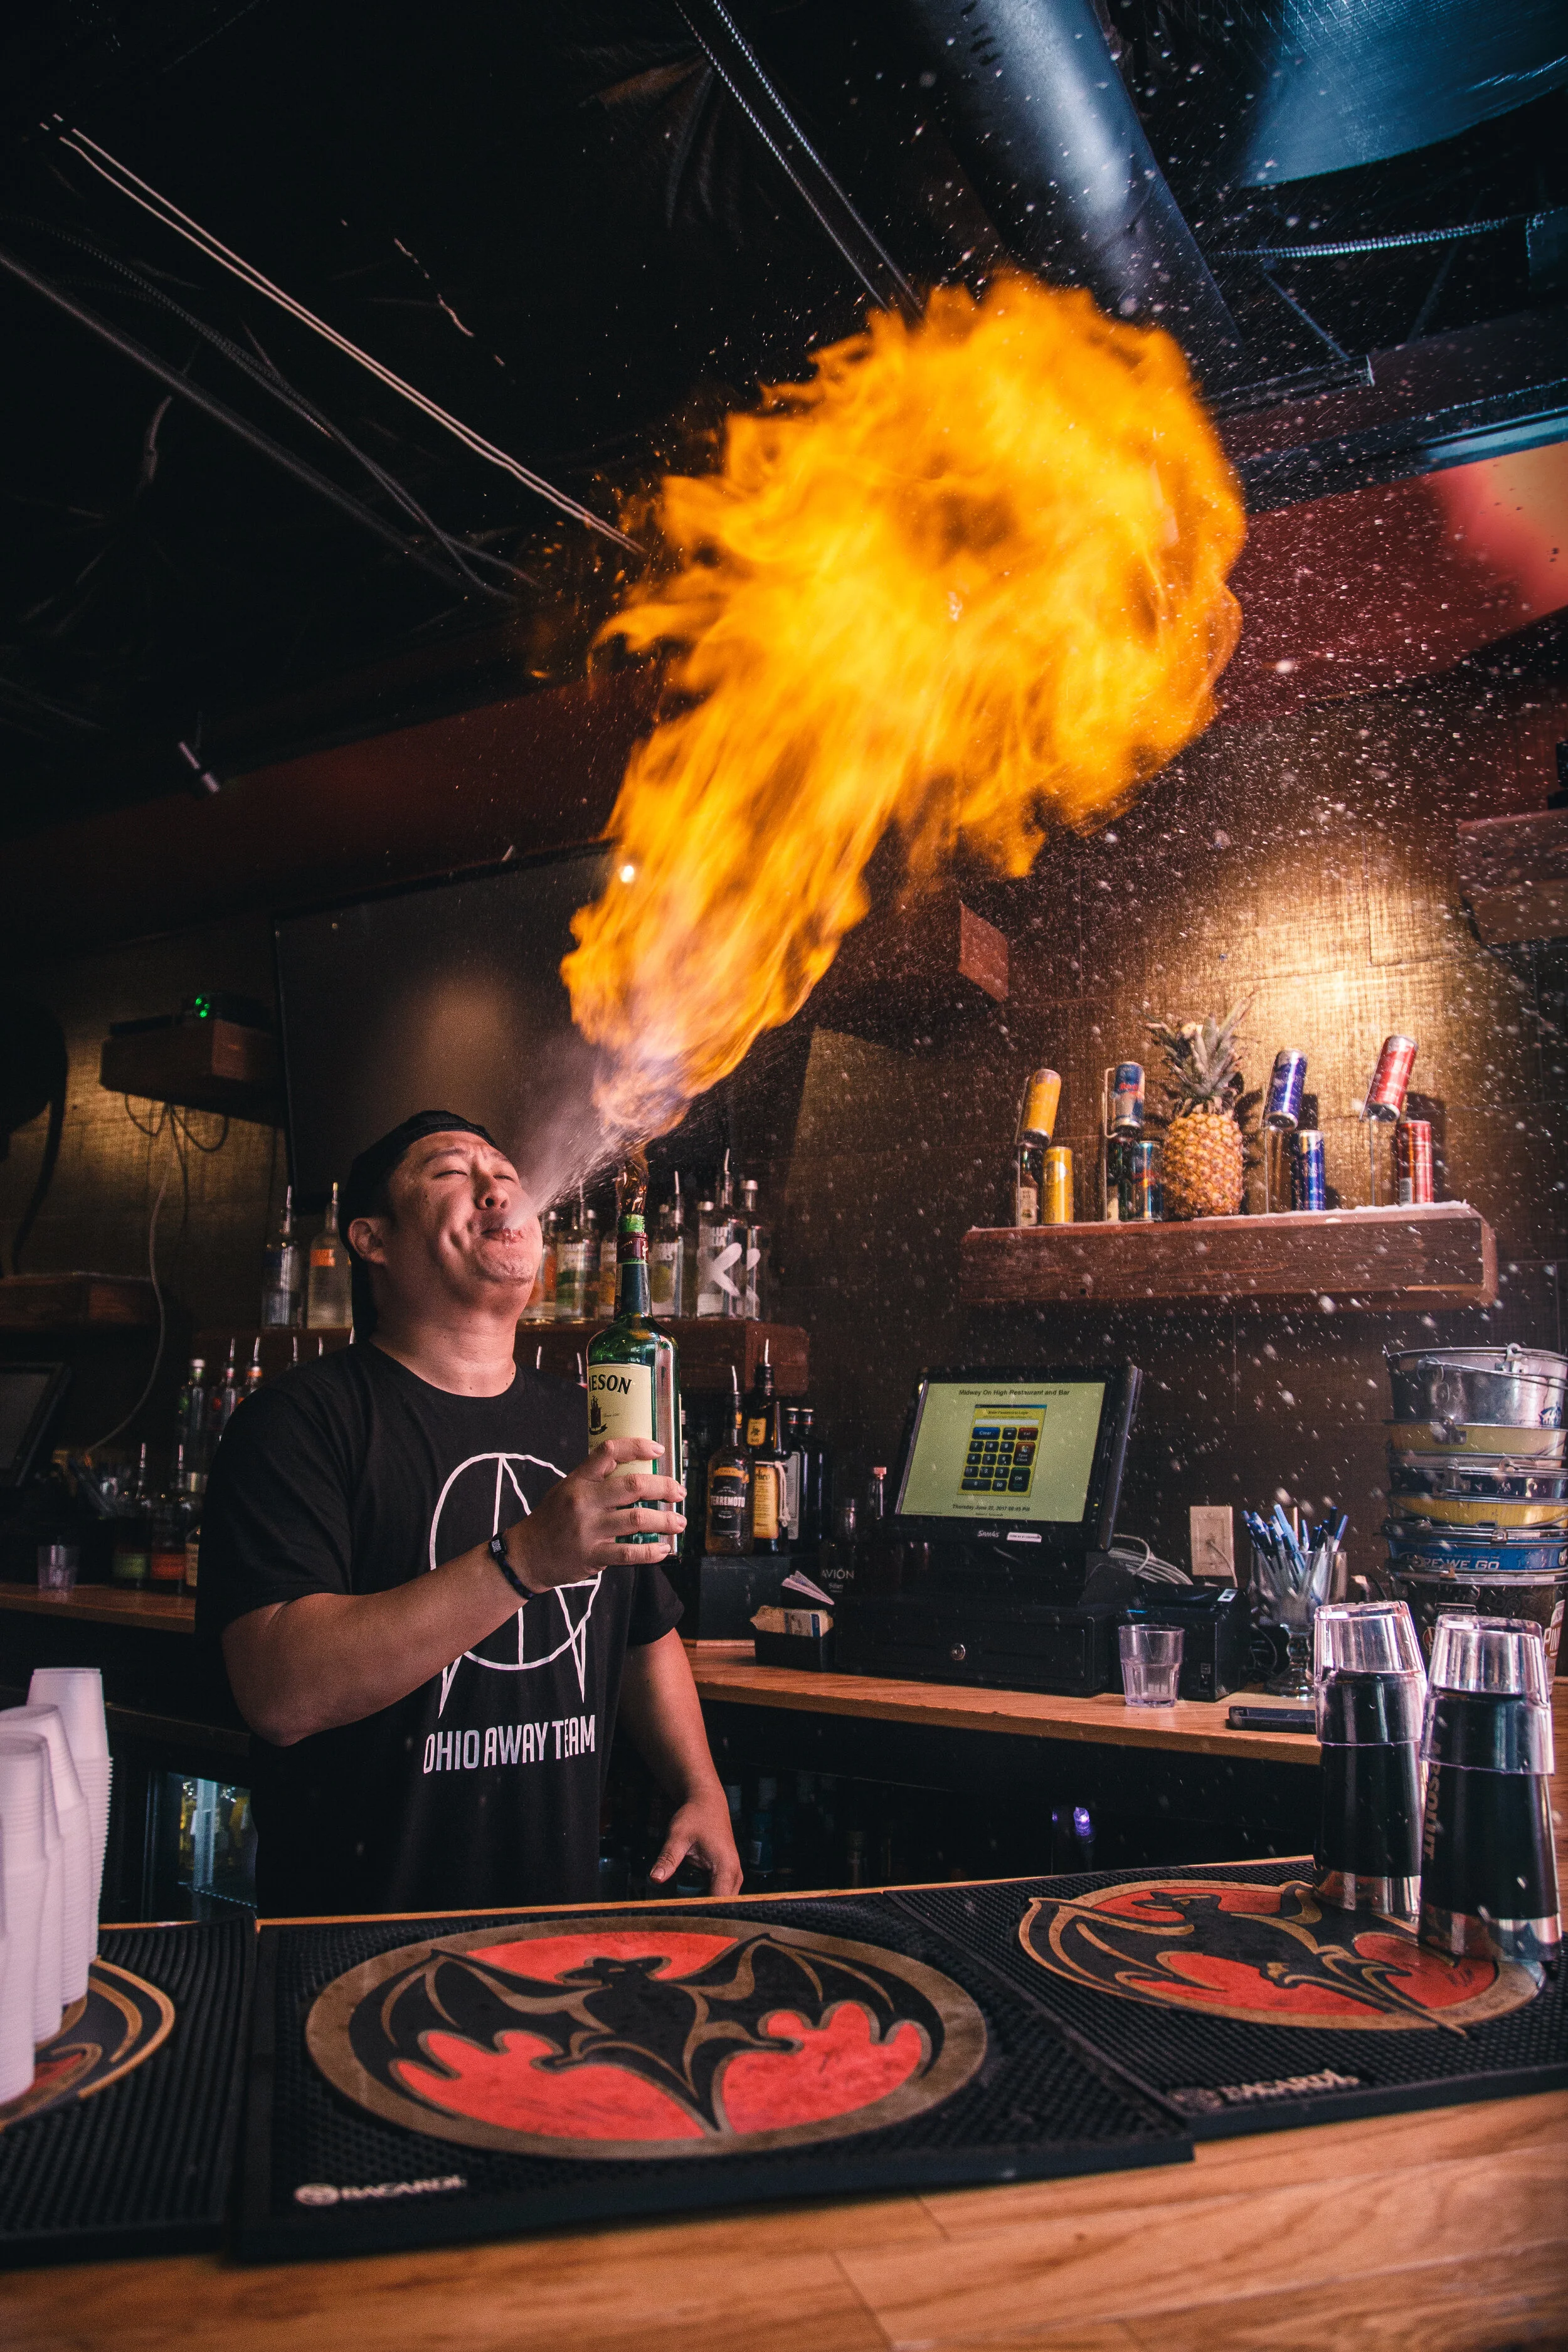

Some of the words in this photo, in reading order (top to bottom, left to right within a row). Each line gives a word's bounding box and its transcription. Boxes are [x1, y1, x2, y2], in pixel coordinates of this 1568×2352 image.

[589, 1374, 632, 1395] ESON
[710, 1496, 745, 1507] TERREMOTO
[1475, 1560, 1500, 1569] GO
[423, 1729, 480, 1774] OHIO
[484, 1722, 548, 1767] AWAY
[551, 1714, 596, 1760] TEAM
